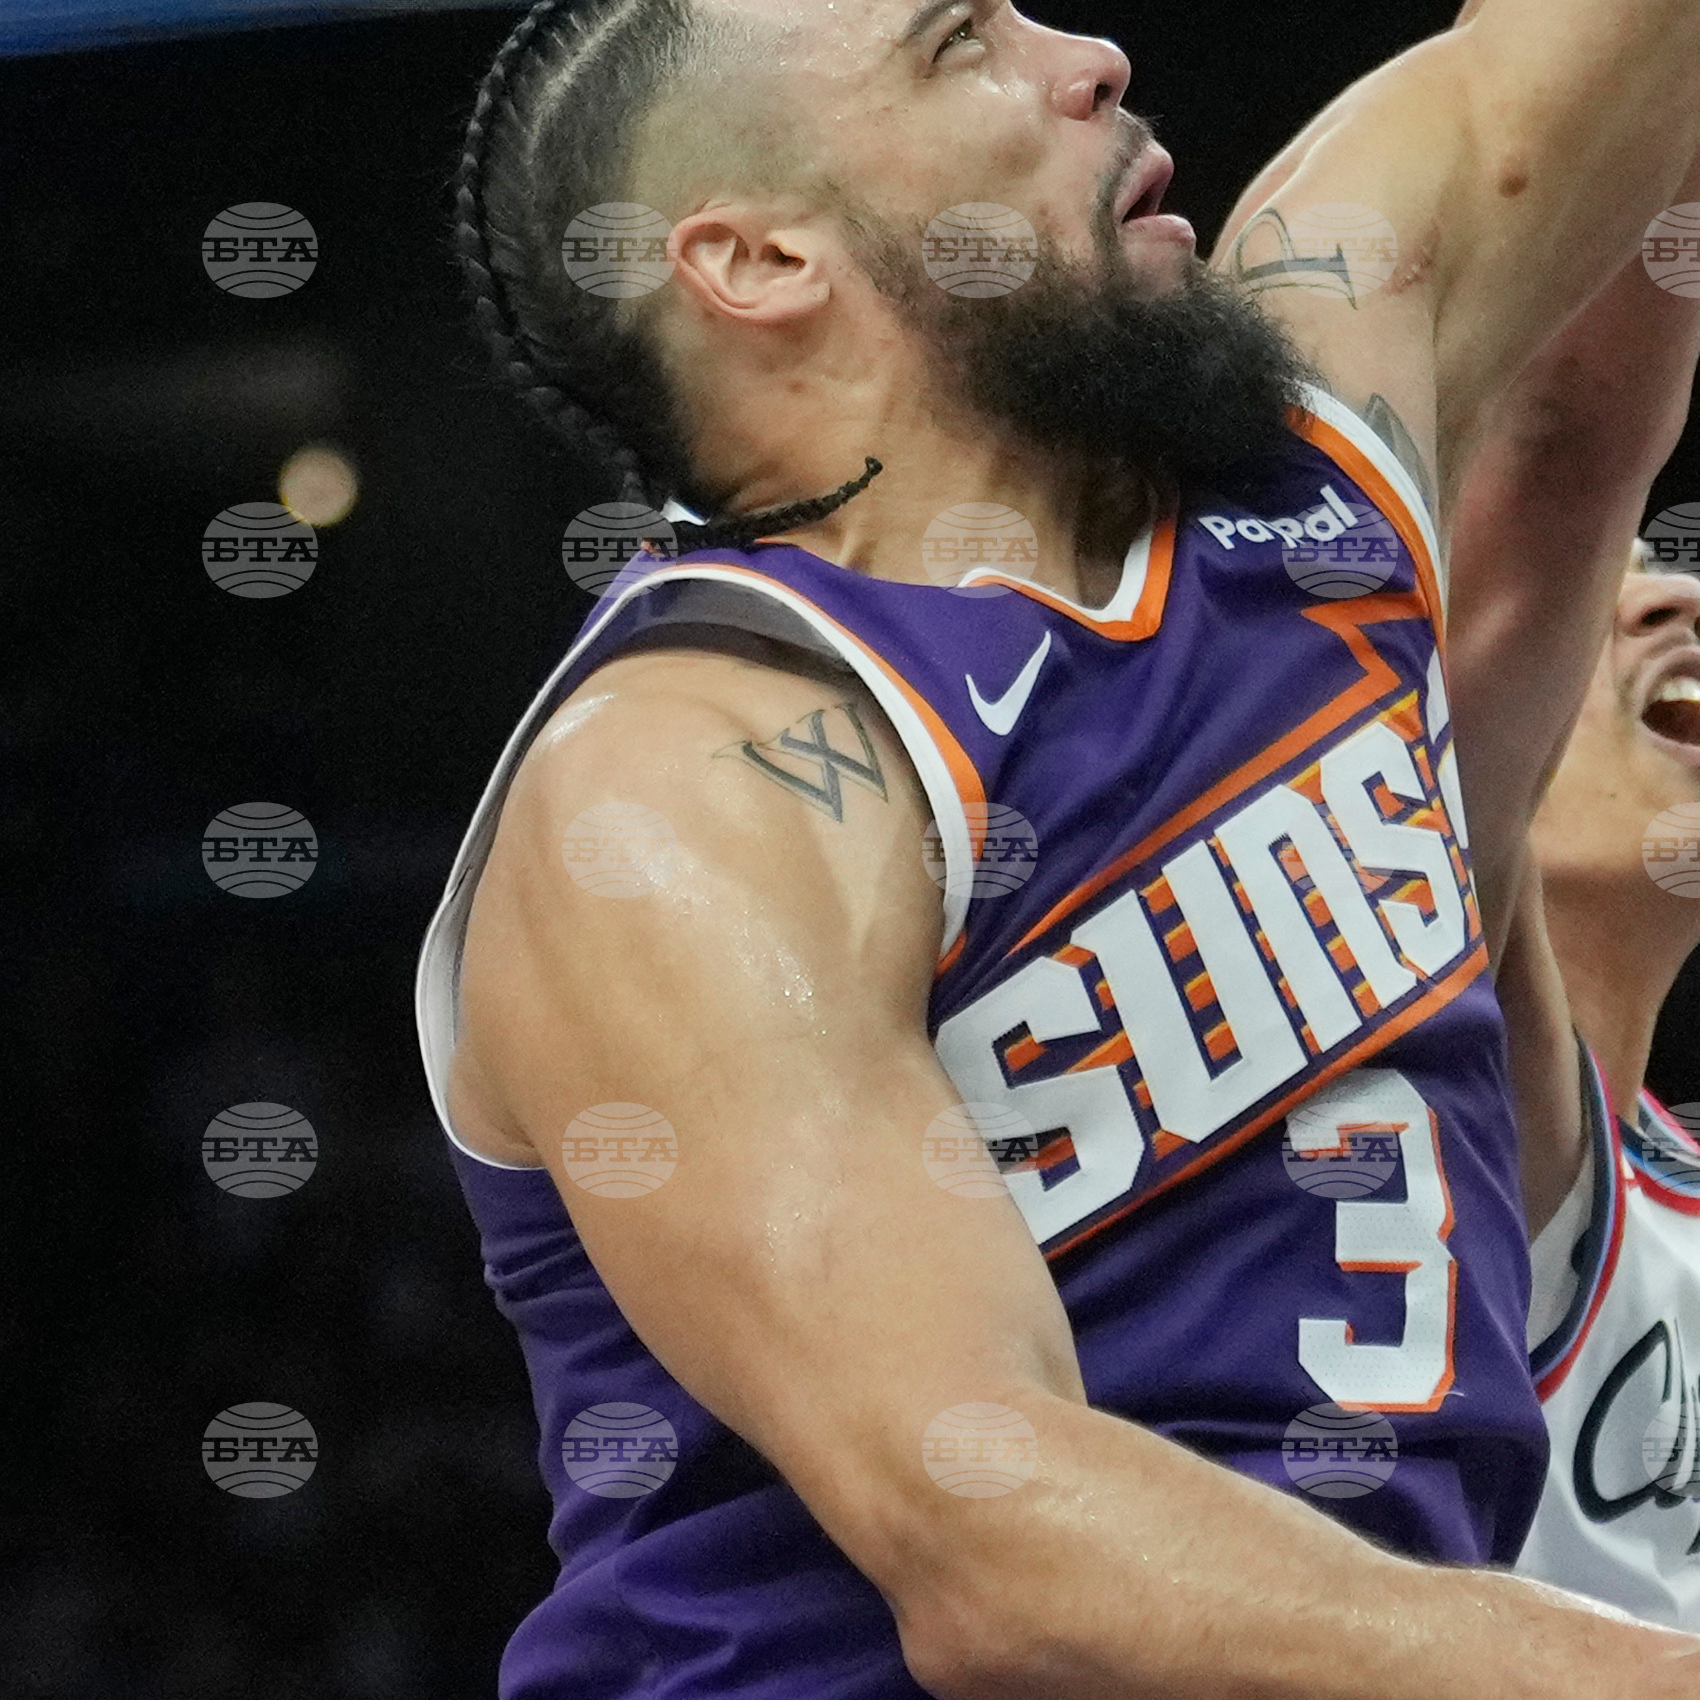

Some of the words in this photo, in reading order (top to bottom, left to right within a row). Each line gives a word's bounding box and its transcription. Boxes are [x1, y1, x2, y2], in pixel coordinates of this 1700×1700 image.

[1198, 484, 1358, 550] PaPal
[935, 721, 1466, 1245] SUNS
[1286, 1068, 1455, 1412] 3
